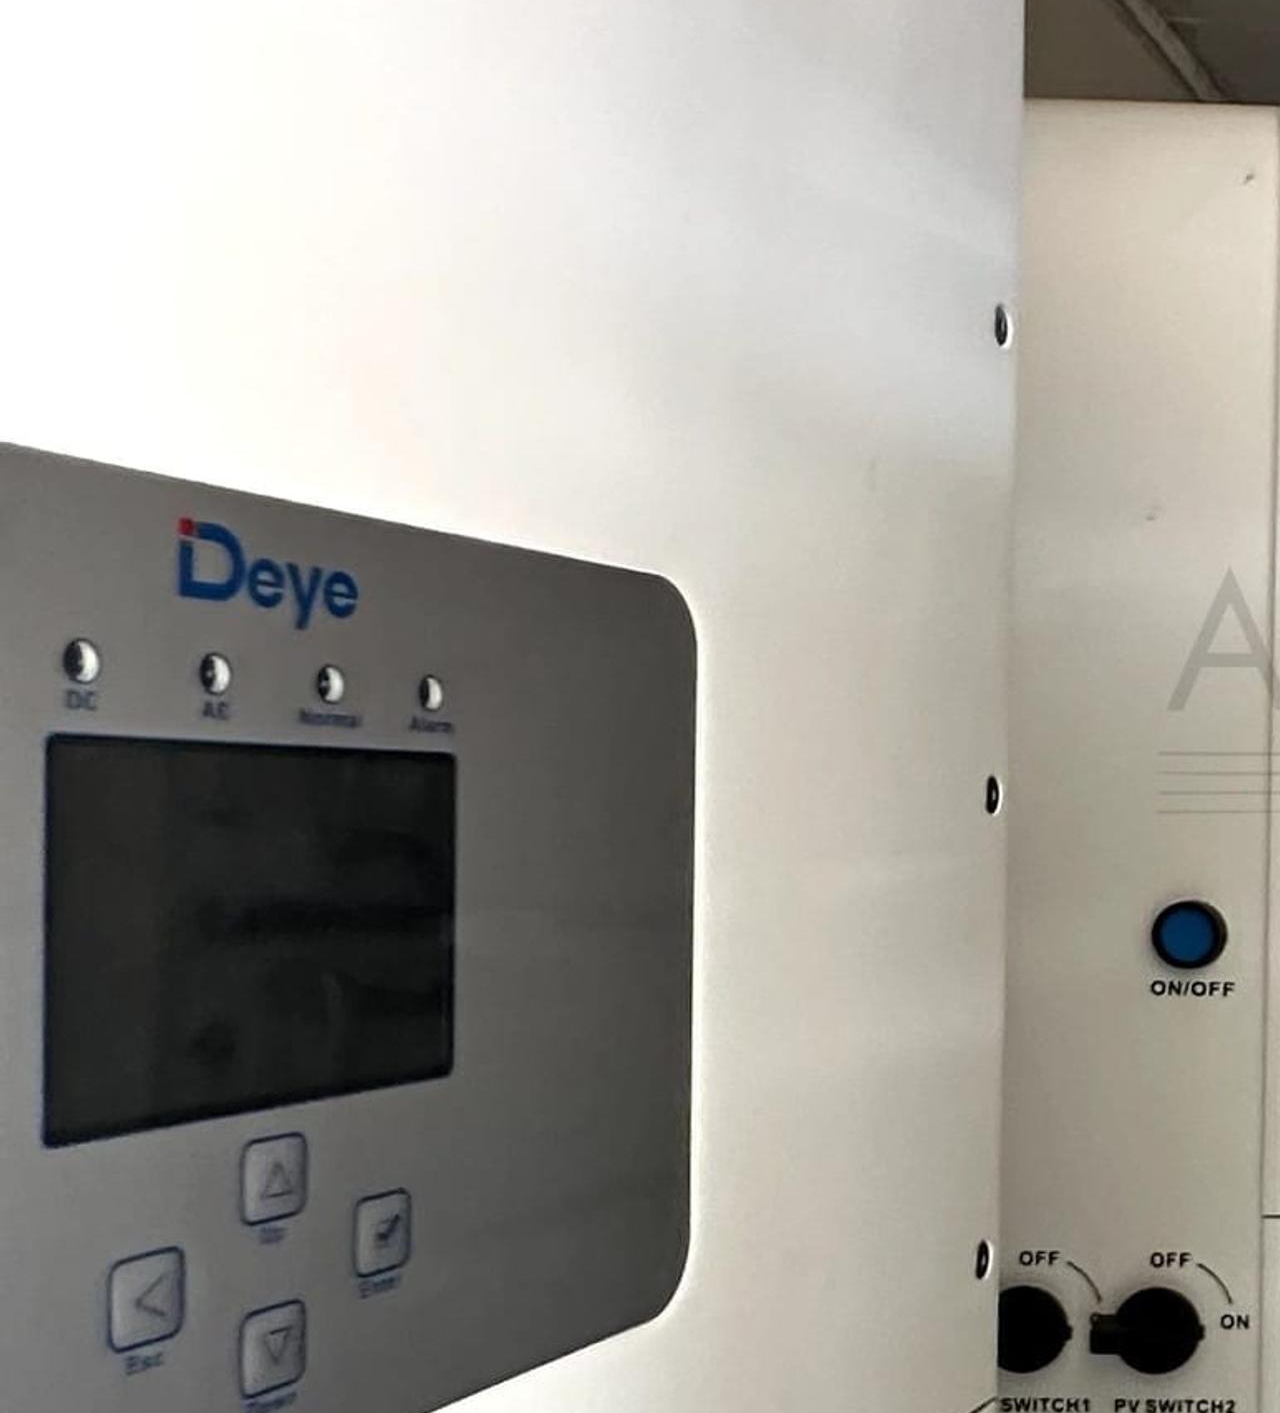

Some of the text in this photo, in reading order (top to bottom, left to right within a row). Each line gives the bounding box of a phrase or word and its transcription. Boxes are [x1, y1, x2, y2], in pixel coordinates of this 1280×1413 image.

[177, 517, 359, 629] Deye
[65, 689, 98, 712] DC
[1150, 979, 1235, 997] ON/OFF
[1019, 1250, 1061, 1267] OFF
[1150, 1252, 1192, 1268] OFF
[1219, 1313, 1250, 1330] ON
[1000, 1397, 1091, 1413] SWITCH1
